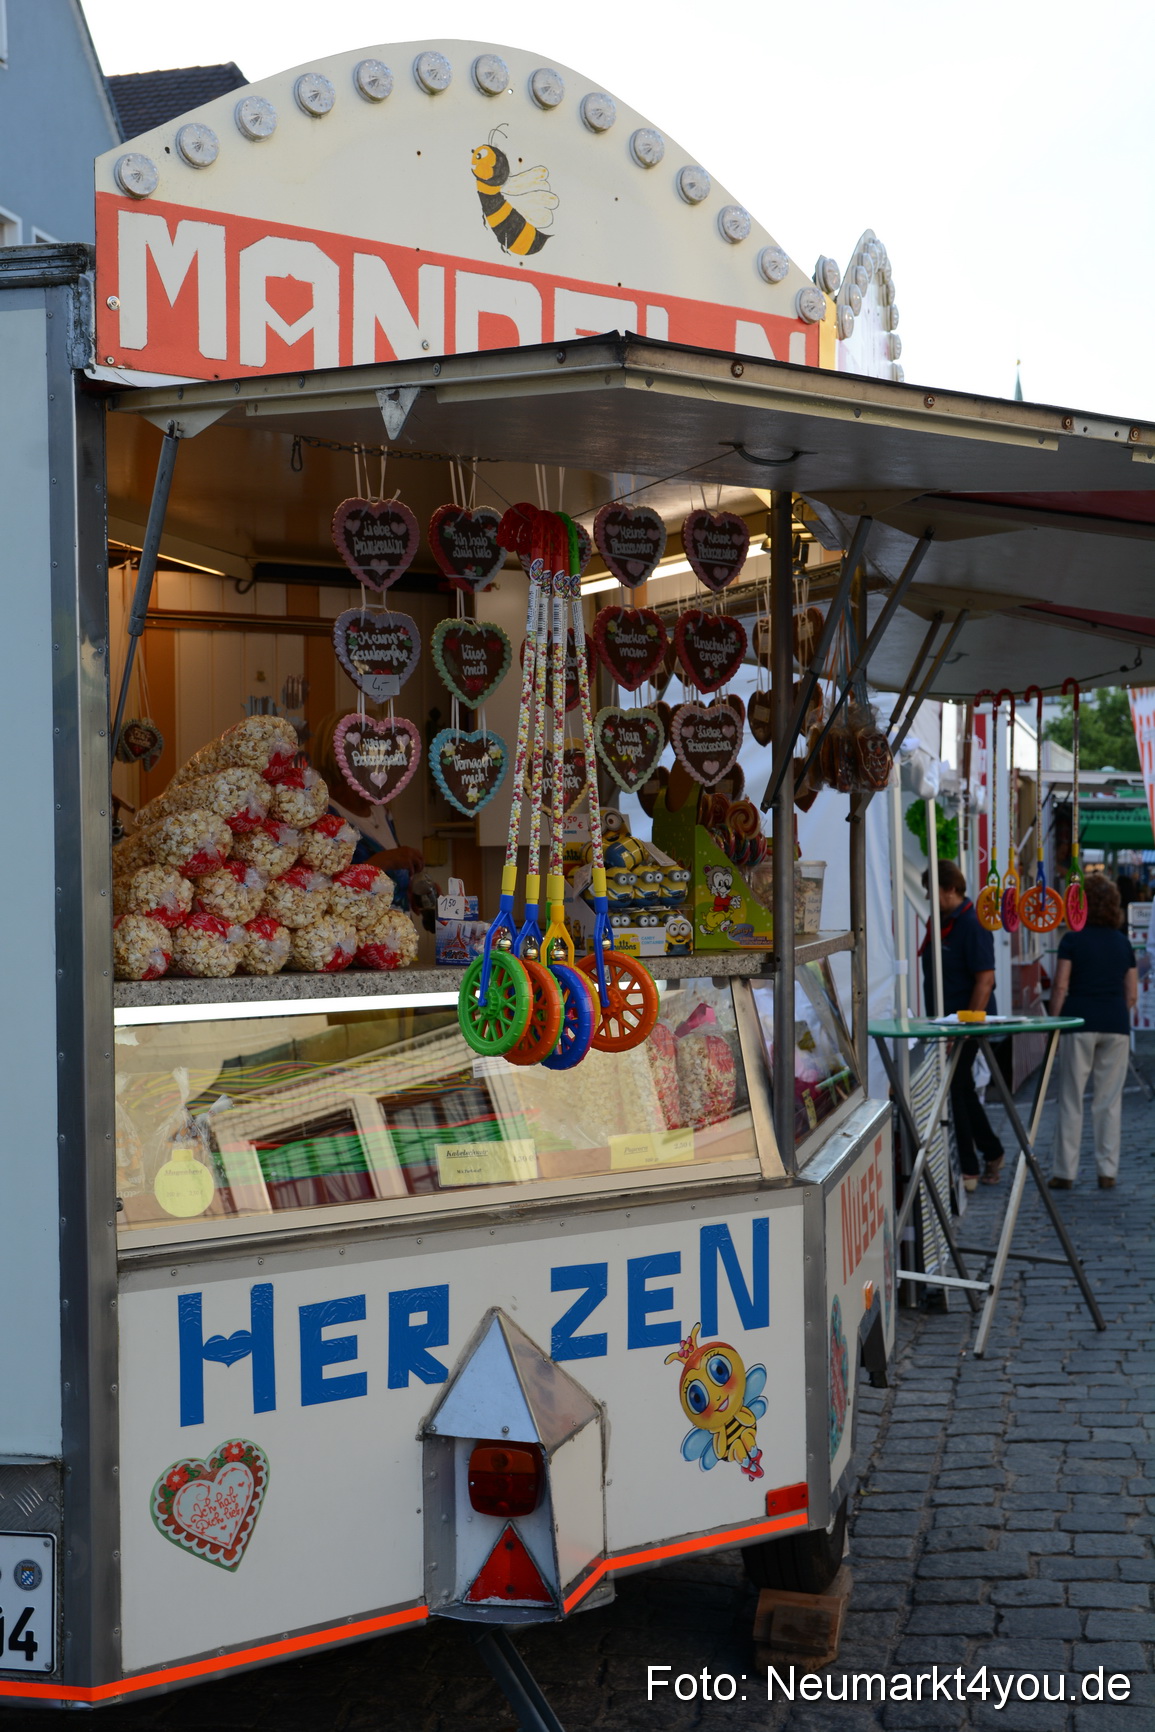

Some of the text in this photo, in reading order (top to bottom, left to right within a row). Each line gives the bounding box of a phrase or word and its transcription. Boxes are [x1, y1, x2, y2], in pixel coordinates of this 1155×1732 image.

[700, 651, 728, 668] engel
[462, 661, 488, 675] mich
[618, 727, 640, 741] Mein
